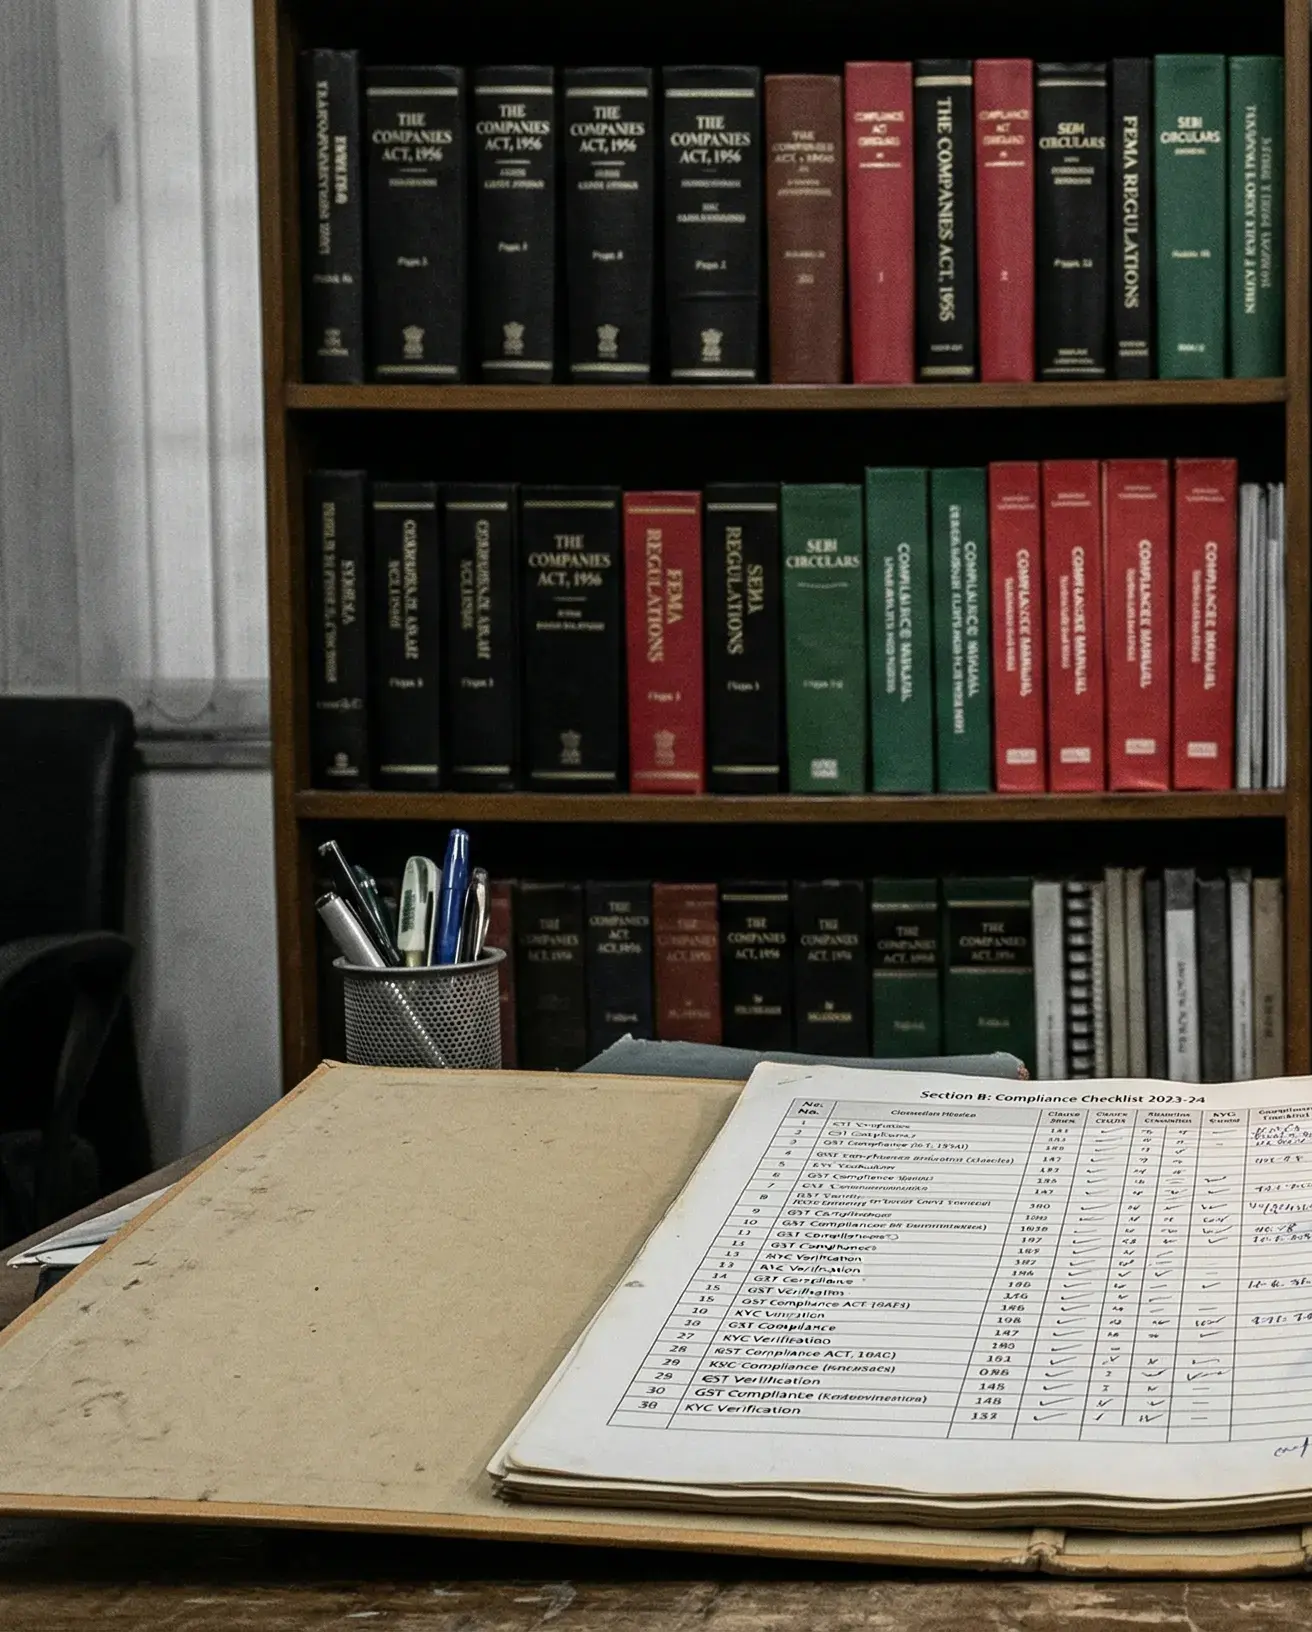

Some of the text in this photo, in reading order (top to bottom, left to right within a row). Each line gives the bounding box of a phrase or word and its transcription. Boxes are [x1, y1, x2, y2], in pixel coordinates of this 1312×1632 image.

[397, 112, 427, 127] THE
[498, 104, 527, 120] THE
[593, 106, 621, 120] THE
[936, 96, 953, 134] THE
[476, 120, 551, 136] COMPANIES
[570, 122, 646, 138] COMPANIES
[695, 115, 725, 131] THE
[372, 129, 453, 145] COMPANIES
[515, 136, 543, 151] 1956
[670, 132, 752, 148] COMPANIES
[609, 138, 637, 153] 1956
[414, 146, 444, 162] 1956
[713, 149, 742, 164] 1956
[937, 137, 955, 242] COMPANIES
[1122, 115, 1140, 309] FEMA REGULATIONS
[554, 534, 585, 549] THE
[806, 538, 838, 553] SEBI
[528, 553, 612, 568] COMPANIES
[785, 554, 861, 570] CIRCULARS
[645, 527, 665, 664] REGULATIONS
[666, 568, 684, 625] FEMA
[724, 525, 744, 656] REGULATIONS
[745, 917, 768, 930] THE
[727, 931, 787, 945] COMPANIES
[920, 1091, 973, 1100] Section
[996, 1093, 1077, 1104] Compliance
[1082, 1094, 1144, 1103] Checklist
[1149, 1095, 1206, 1104] 2023-24
[676, 1332, 695, 1340] 27
[746, 1349, 821, 1359] Compliance
[741, 1361, 820, 1373] Compliance
[645, 1386, 667, 1395] 30
[695, 1388, 724, 1397] GST
[684, 1403, 802, 1415] KYC Verification
